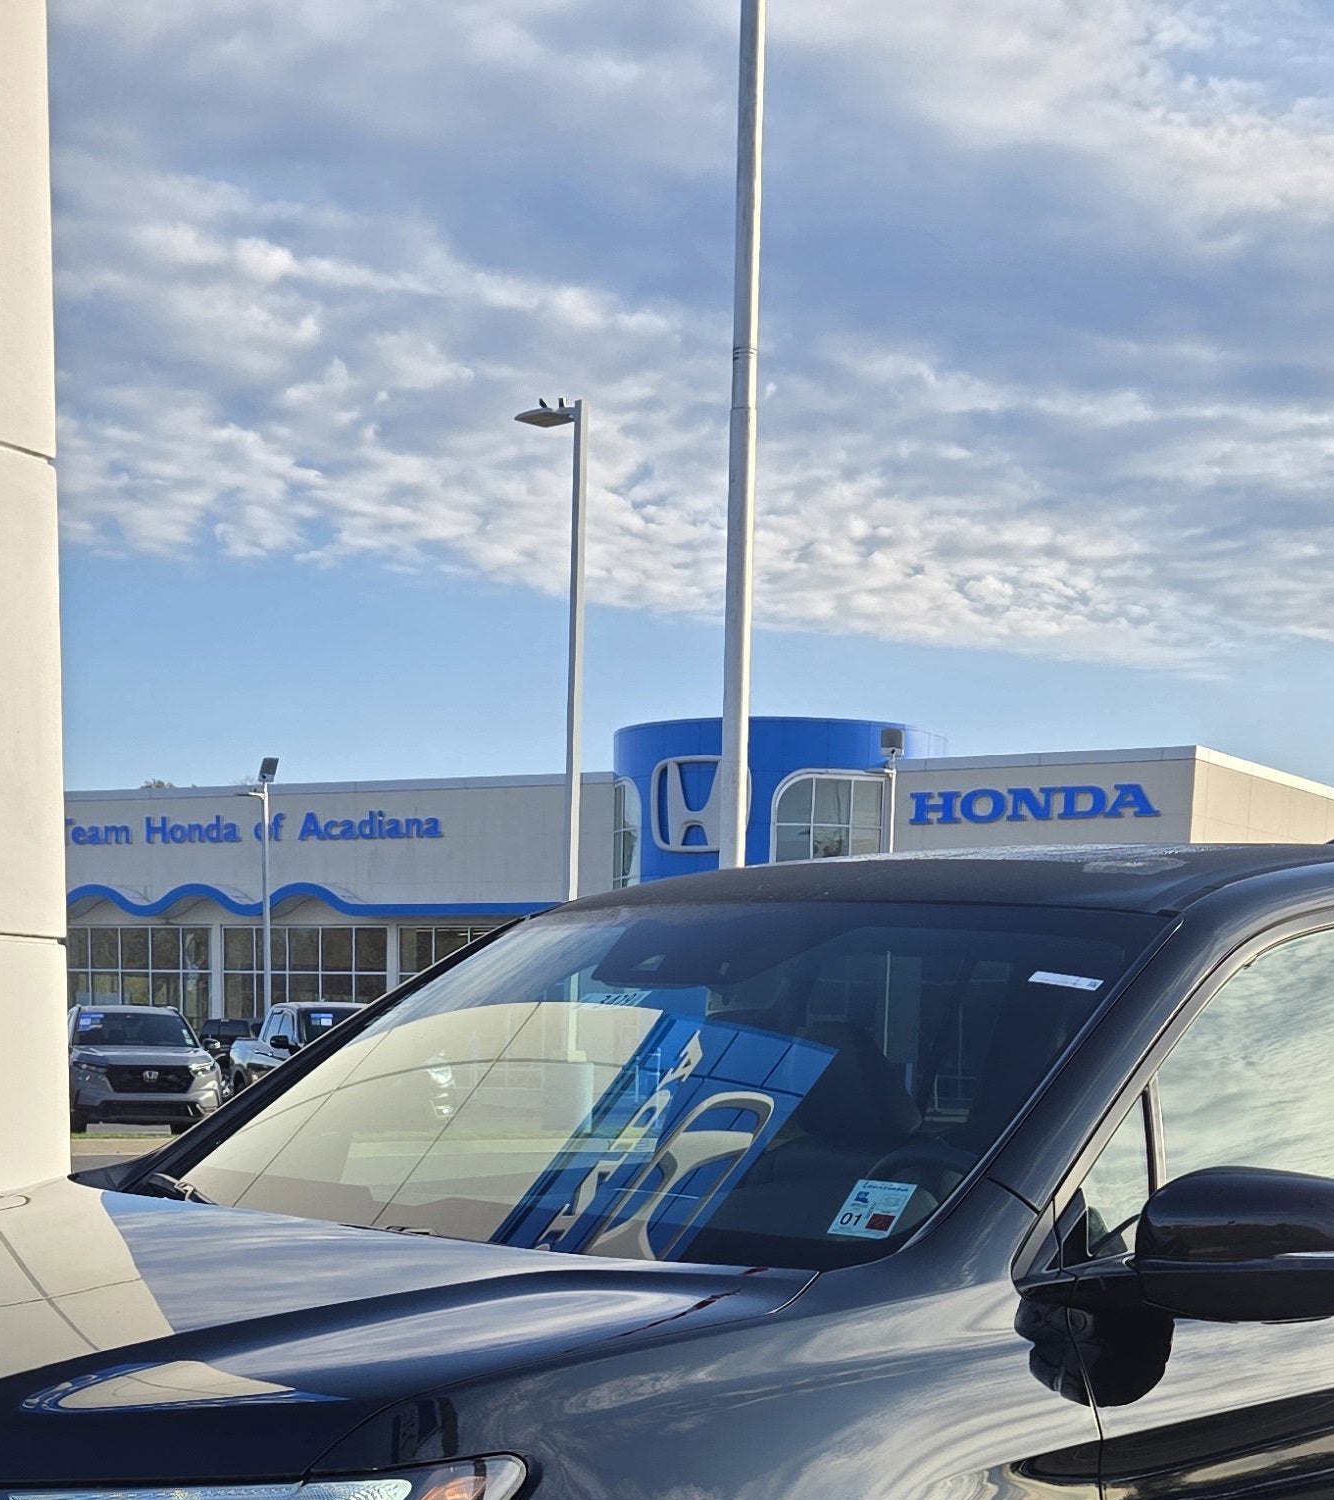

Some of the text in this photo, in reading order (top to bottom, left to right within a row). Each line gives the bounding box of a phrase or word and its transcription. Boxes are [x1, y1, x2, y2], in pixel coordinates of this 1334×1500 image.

[909, 783, 1162, 826] HONDA
[145, 815, 242, 843] Honda
[253, 812, 286, 842] of
[297, 809, 444, 842] Acadiana
[840, 1212, 863, 1226] 01
